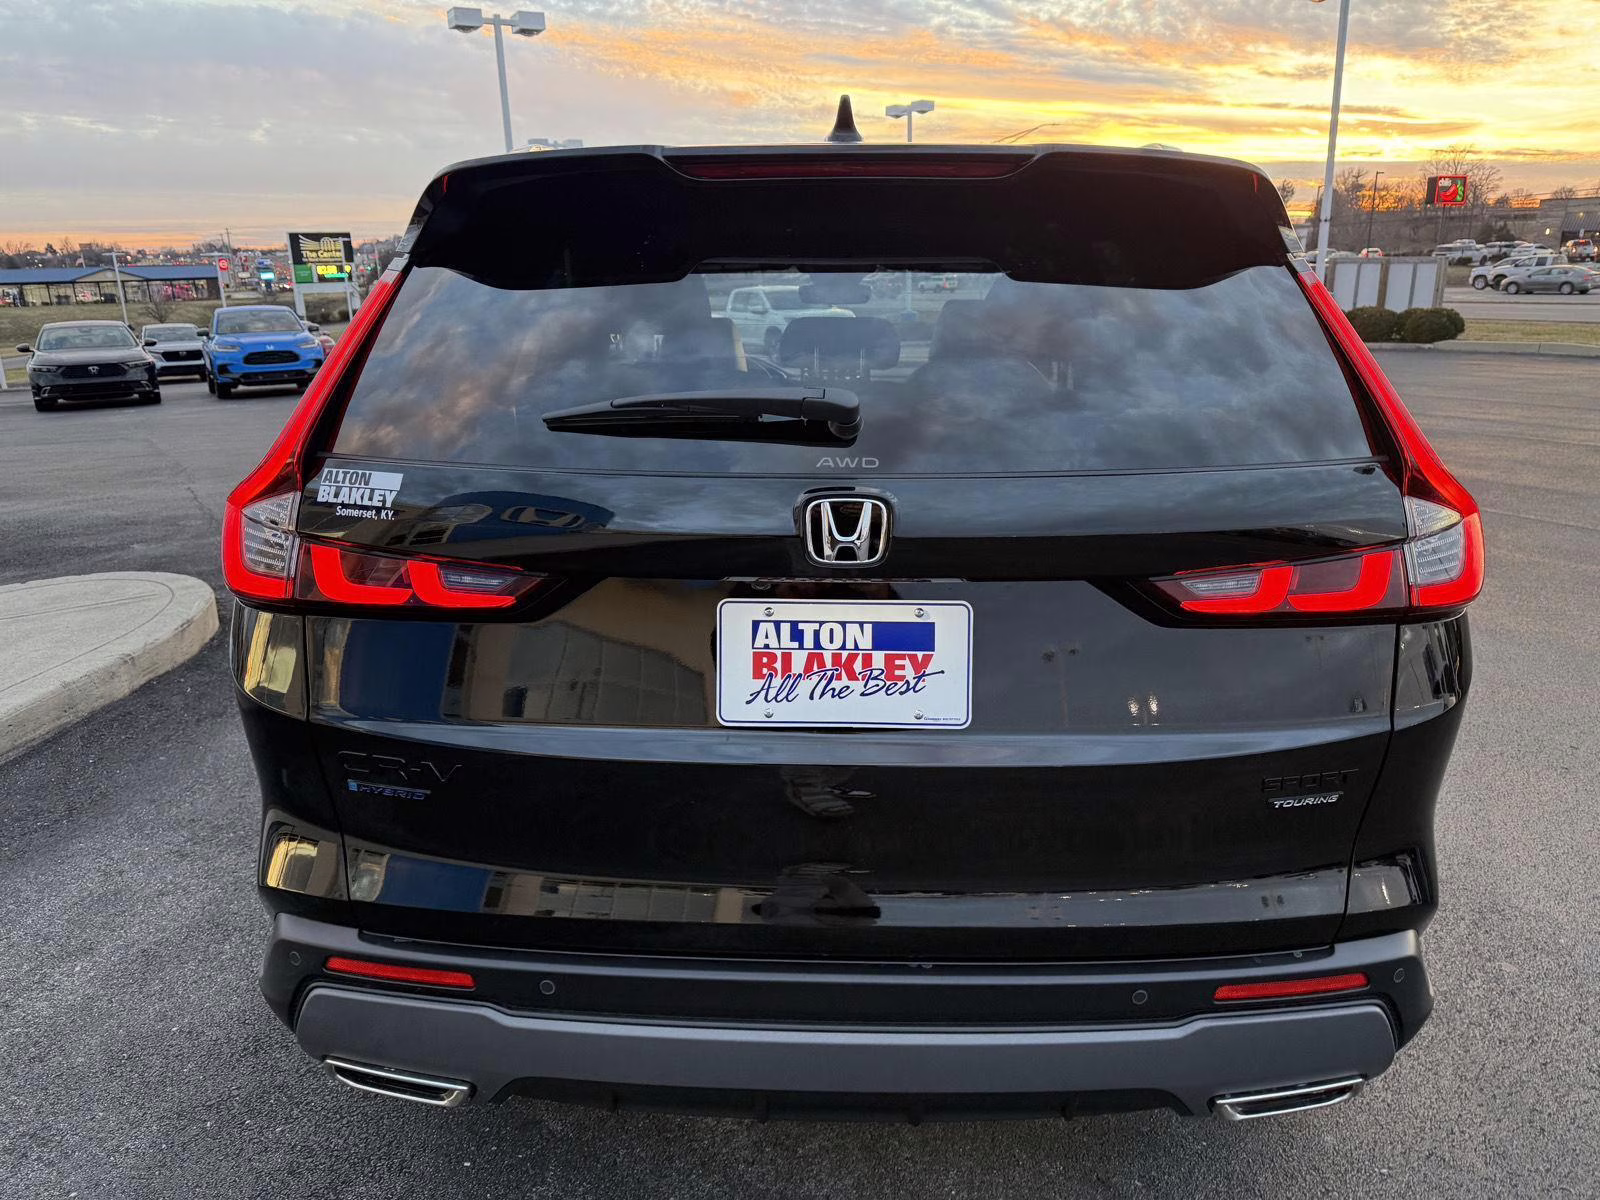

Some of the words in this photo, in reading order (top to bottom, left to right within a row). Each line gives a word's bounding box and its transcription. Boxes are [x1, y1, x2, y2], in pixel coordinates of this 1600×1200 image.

[815, 456, 879, 468] AWD
[322, 469, 373, 486] ALTON
[316, 485, 398, 508] BLAKLEY
[335, 505, 378, 521] Somerset,
[380, 509, 396, 521] KY.
[753, 622, 873, 650] ALTON
[751, 651, 935, 682] BLAKLEY
[745, 672, 803, 705] All
[806, 667, 855, 701] The
[857, 667, 945, 697] Best
[337, 750, 463, 782] CR-V
[359, 784, 427, 801] HYBRID
[1273, 794, 1340, 809] TOURING
